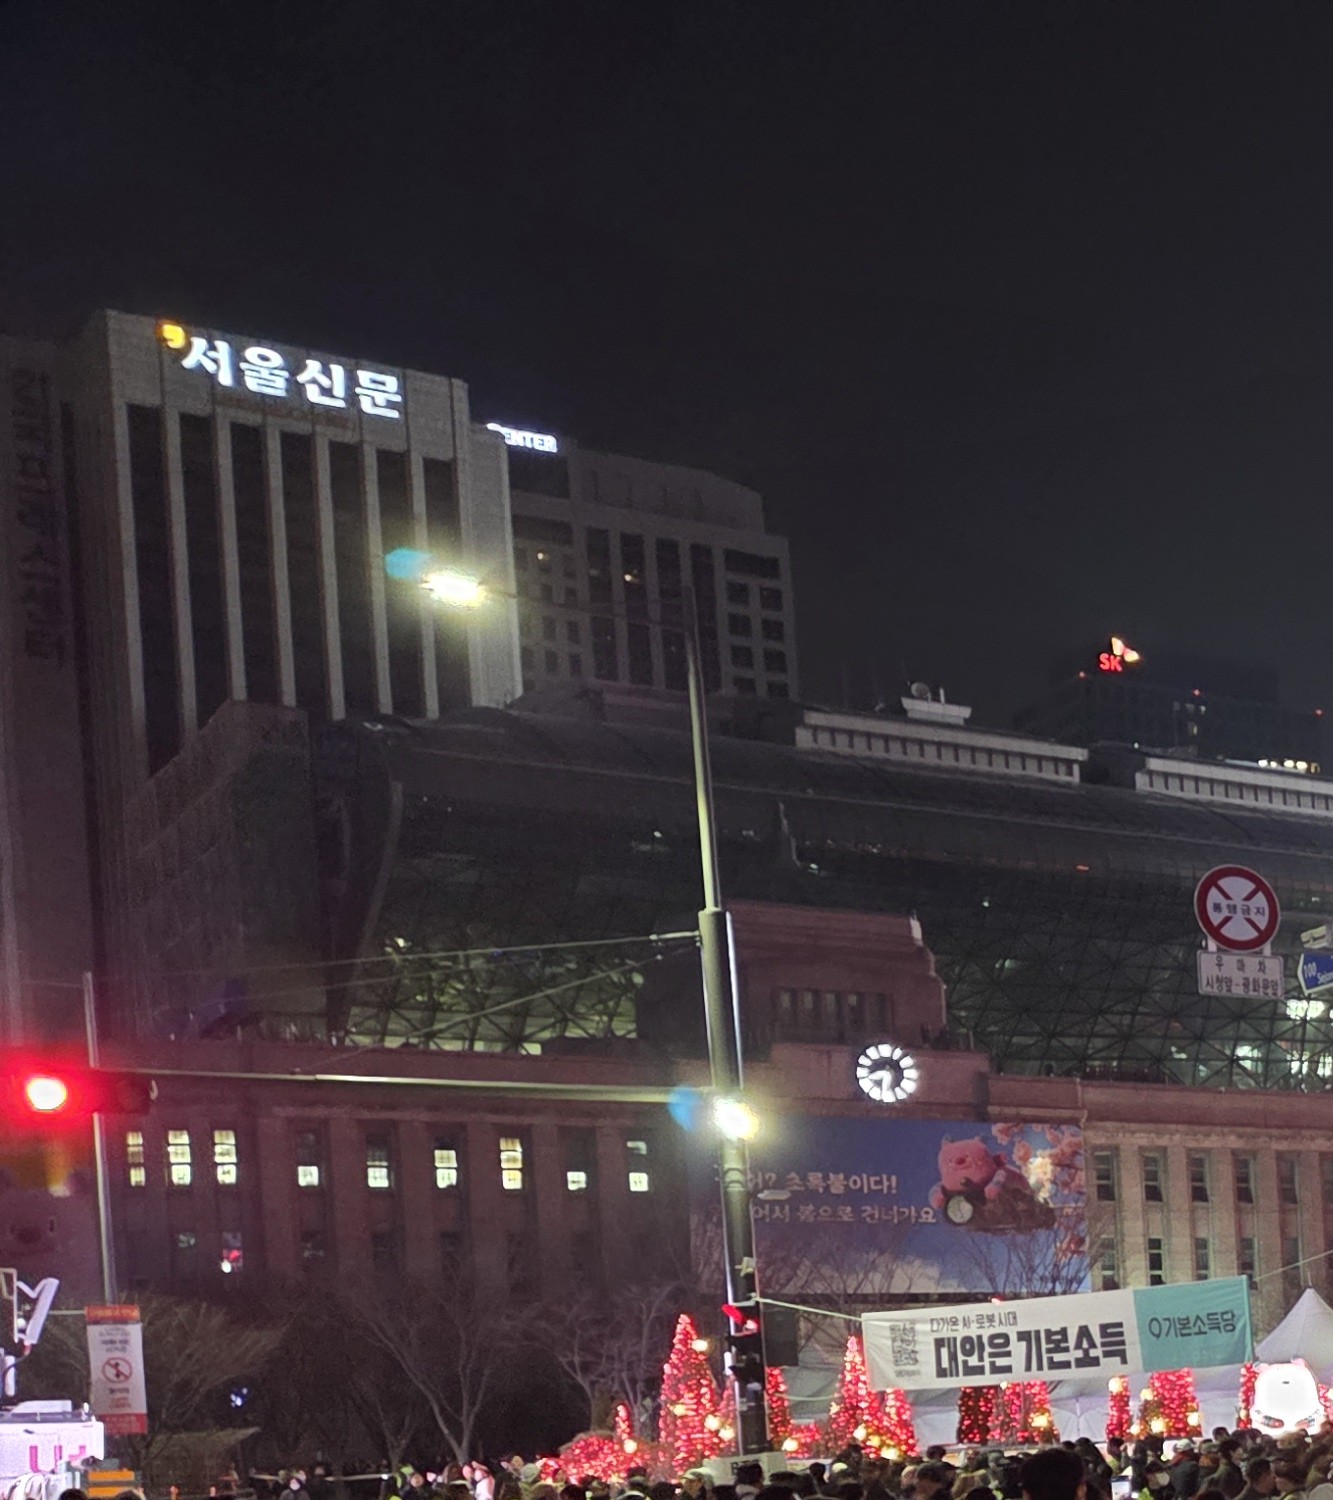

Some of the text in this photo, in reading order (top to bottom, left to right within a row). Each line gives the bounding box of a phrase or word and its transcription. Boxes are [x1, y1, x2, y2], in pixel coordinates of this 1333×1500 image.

[181, 337, 402, 419] 서울신문
[1099, 652, 1123, 672] SK
[752, 1204, 790, 1223] 어서
[861, 1205, 937, 1224] 건너가요
[930, 1316, 960, 1333] 다가온
[998, 1311, 1018, 1327] 시대
[1164, 1309, 1236, 1339] 기본소득당
[934, 1321, 1129, 1378] 대안은 기본소득
